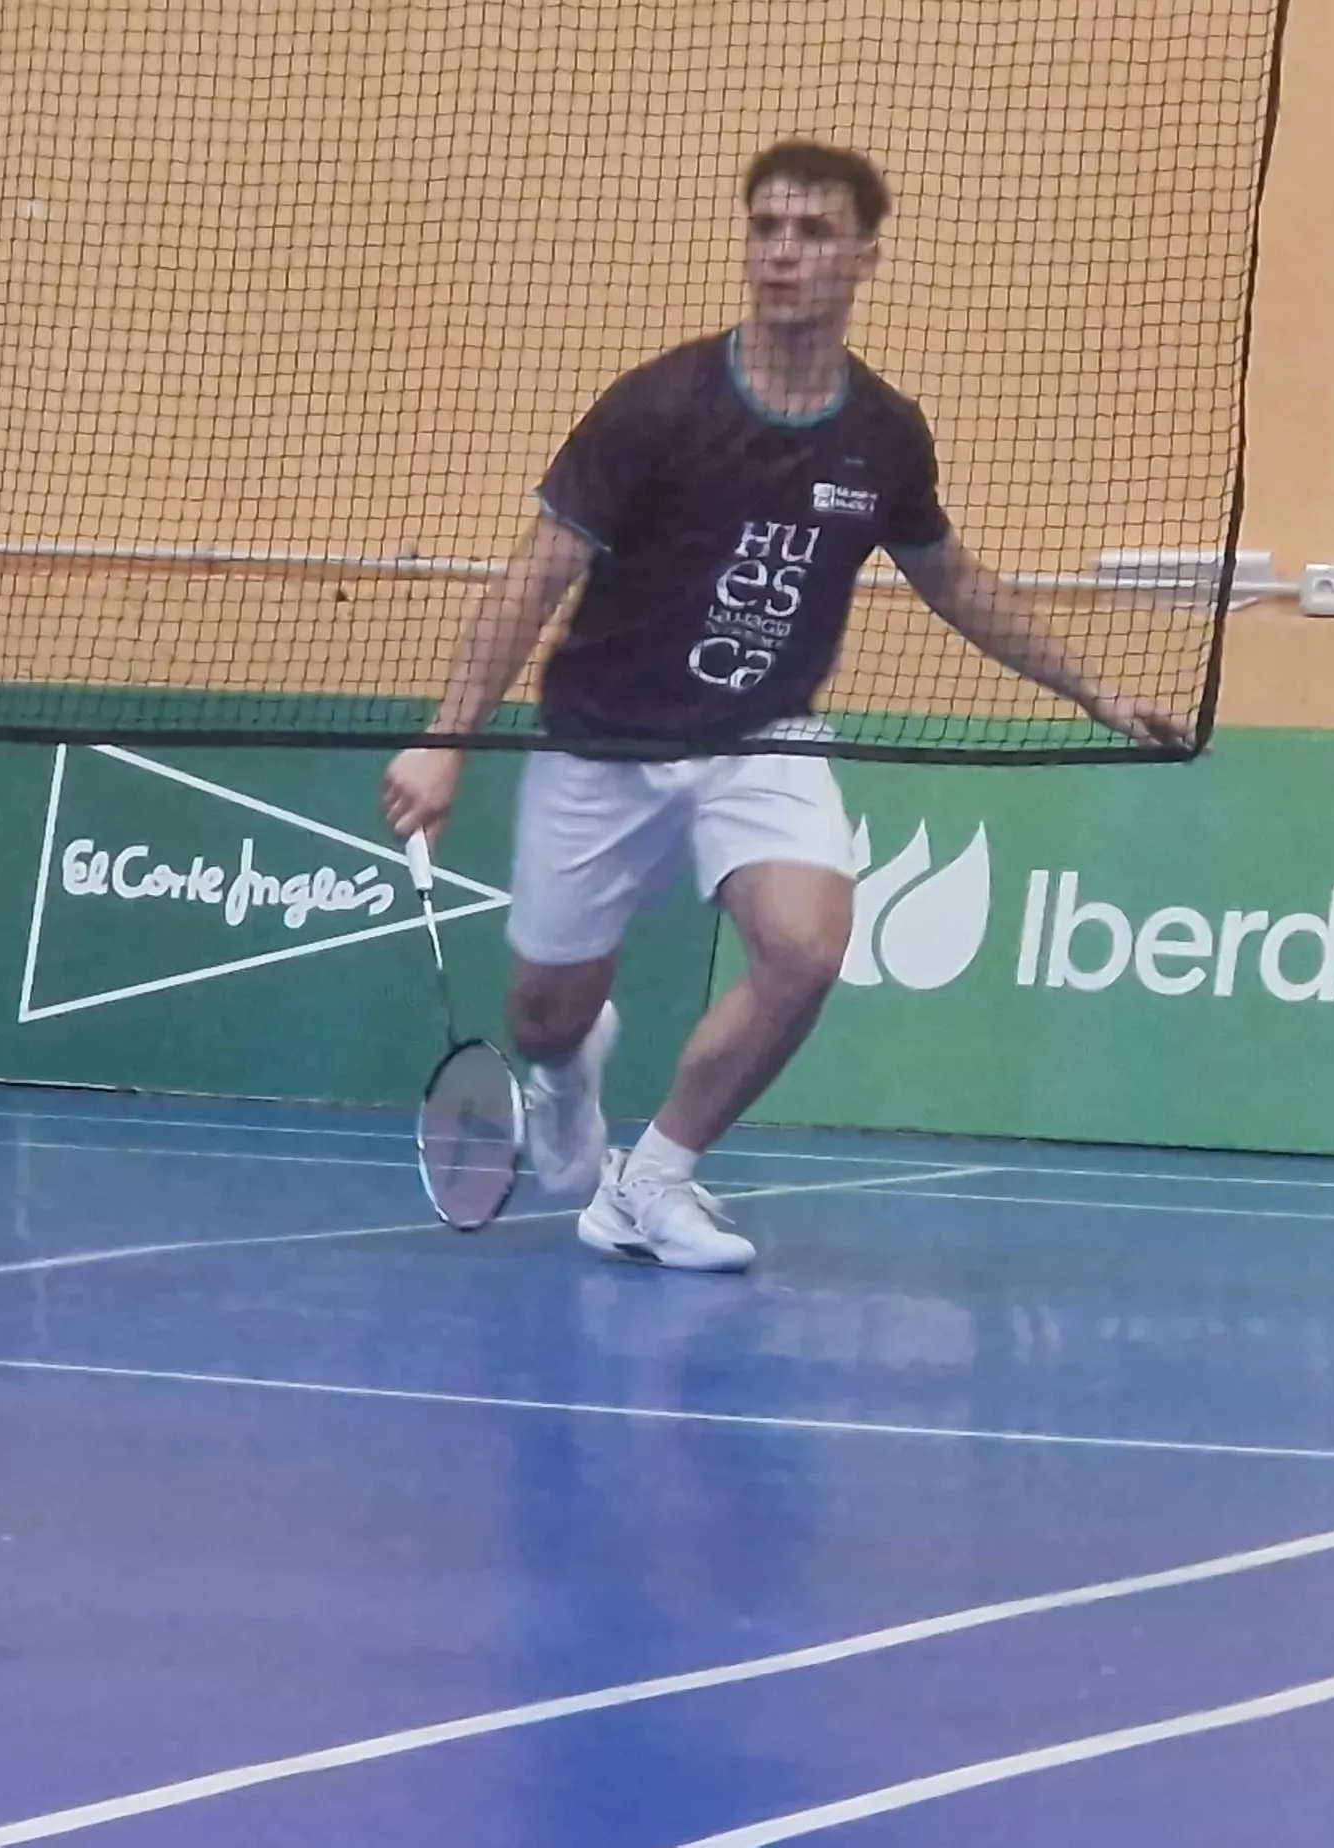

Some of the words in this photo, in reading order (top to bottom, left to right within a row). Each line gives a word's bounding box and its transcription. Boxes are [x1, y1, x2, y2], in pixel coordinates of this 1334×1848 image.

[62, 838, 110, 896] El
[112, 845, 225, 904] Corte
[224, 837, 395, 929] Inglés
